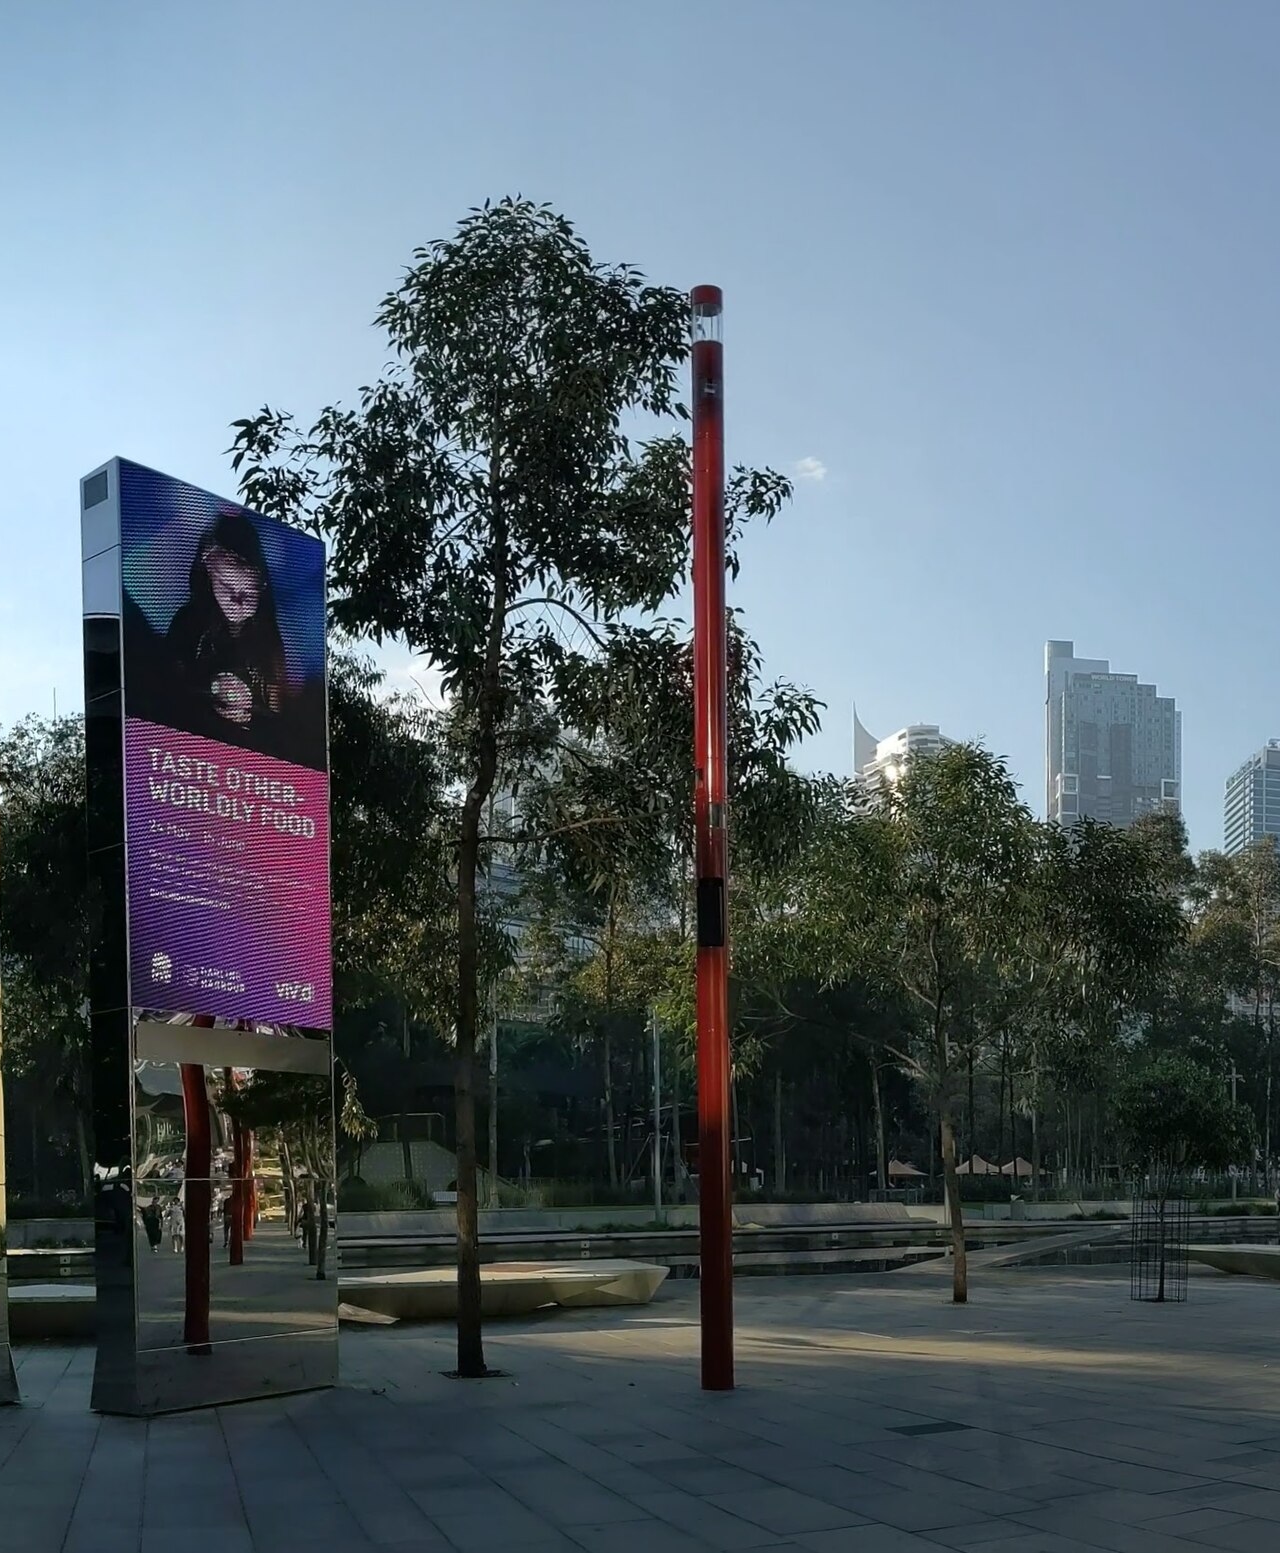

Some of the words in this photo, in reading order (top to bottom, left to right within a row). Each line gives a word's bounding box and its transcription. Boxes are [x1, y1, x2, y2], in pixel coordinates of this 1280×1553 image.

[148, 748, 219, 786] TASTE
[226, 768, 305, 806] OTHER-
[148, 776, 256, 823] WORLDLY
[261, 805, 315, 839] FOOD
